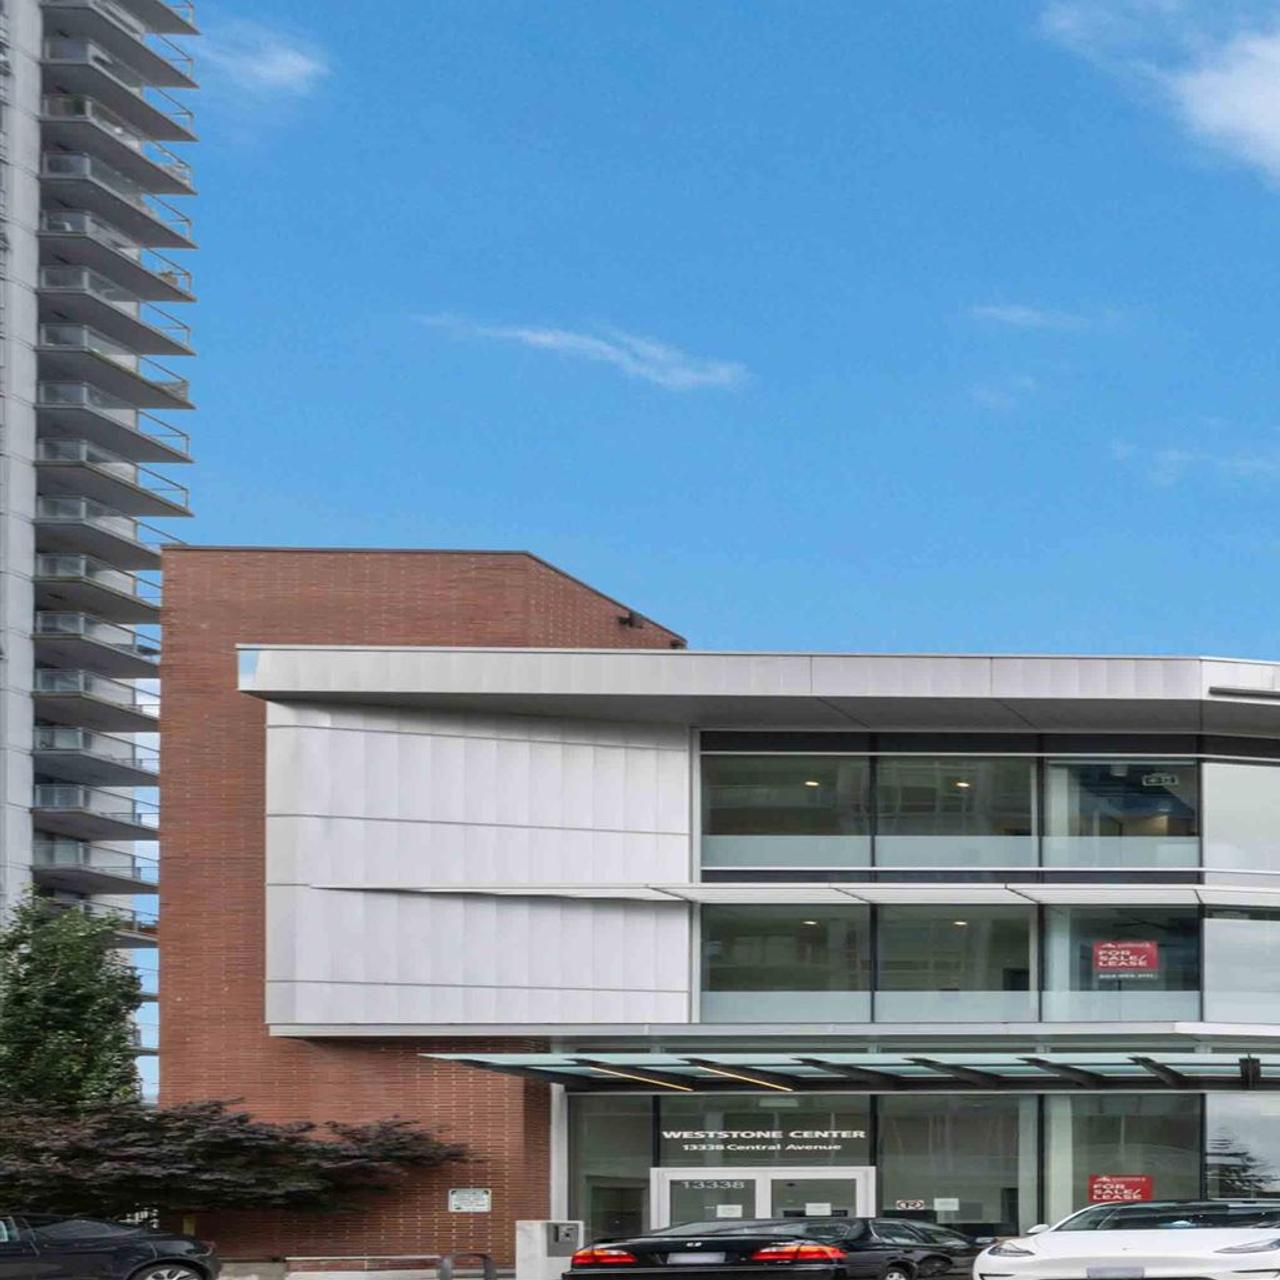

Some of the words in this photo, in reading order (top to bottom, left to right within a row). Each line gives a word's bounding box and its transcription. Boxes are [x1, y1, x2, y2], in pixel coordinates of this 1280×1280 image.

[663, 1130, 783, 1139] WESTSTONE
[789, 1130, 866, 1139] CENTER
[727, 1143, 781, 1151] Central
[682, 1181, 745, 1189] 13338
